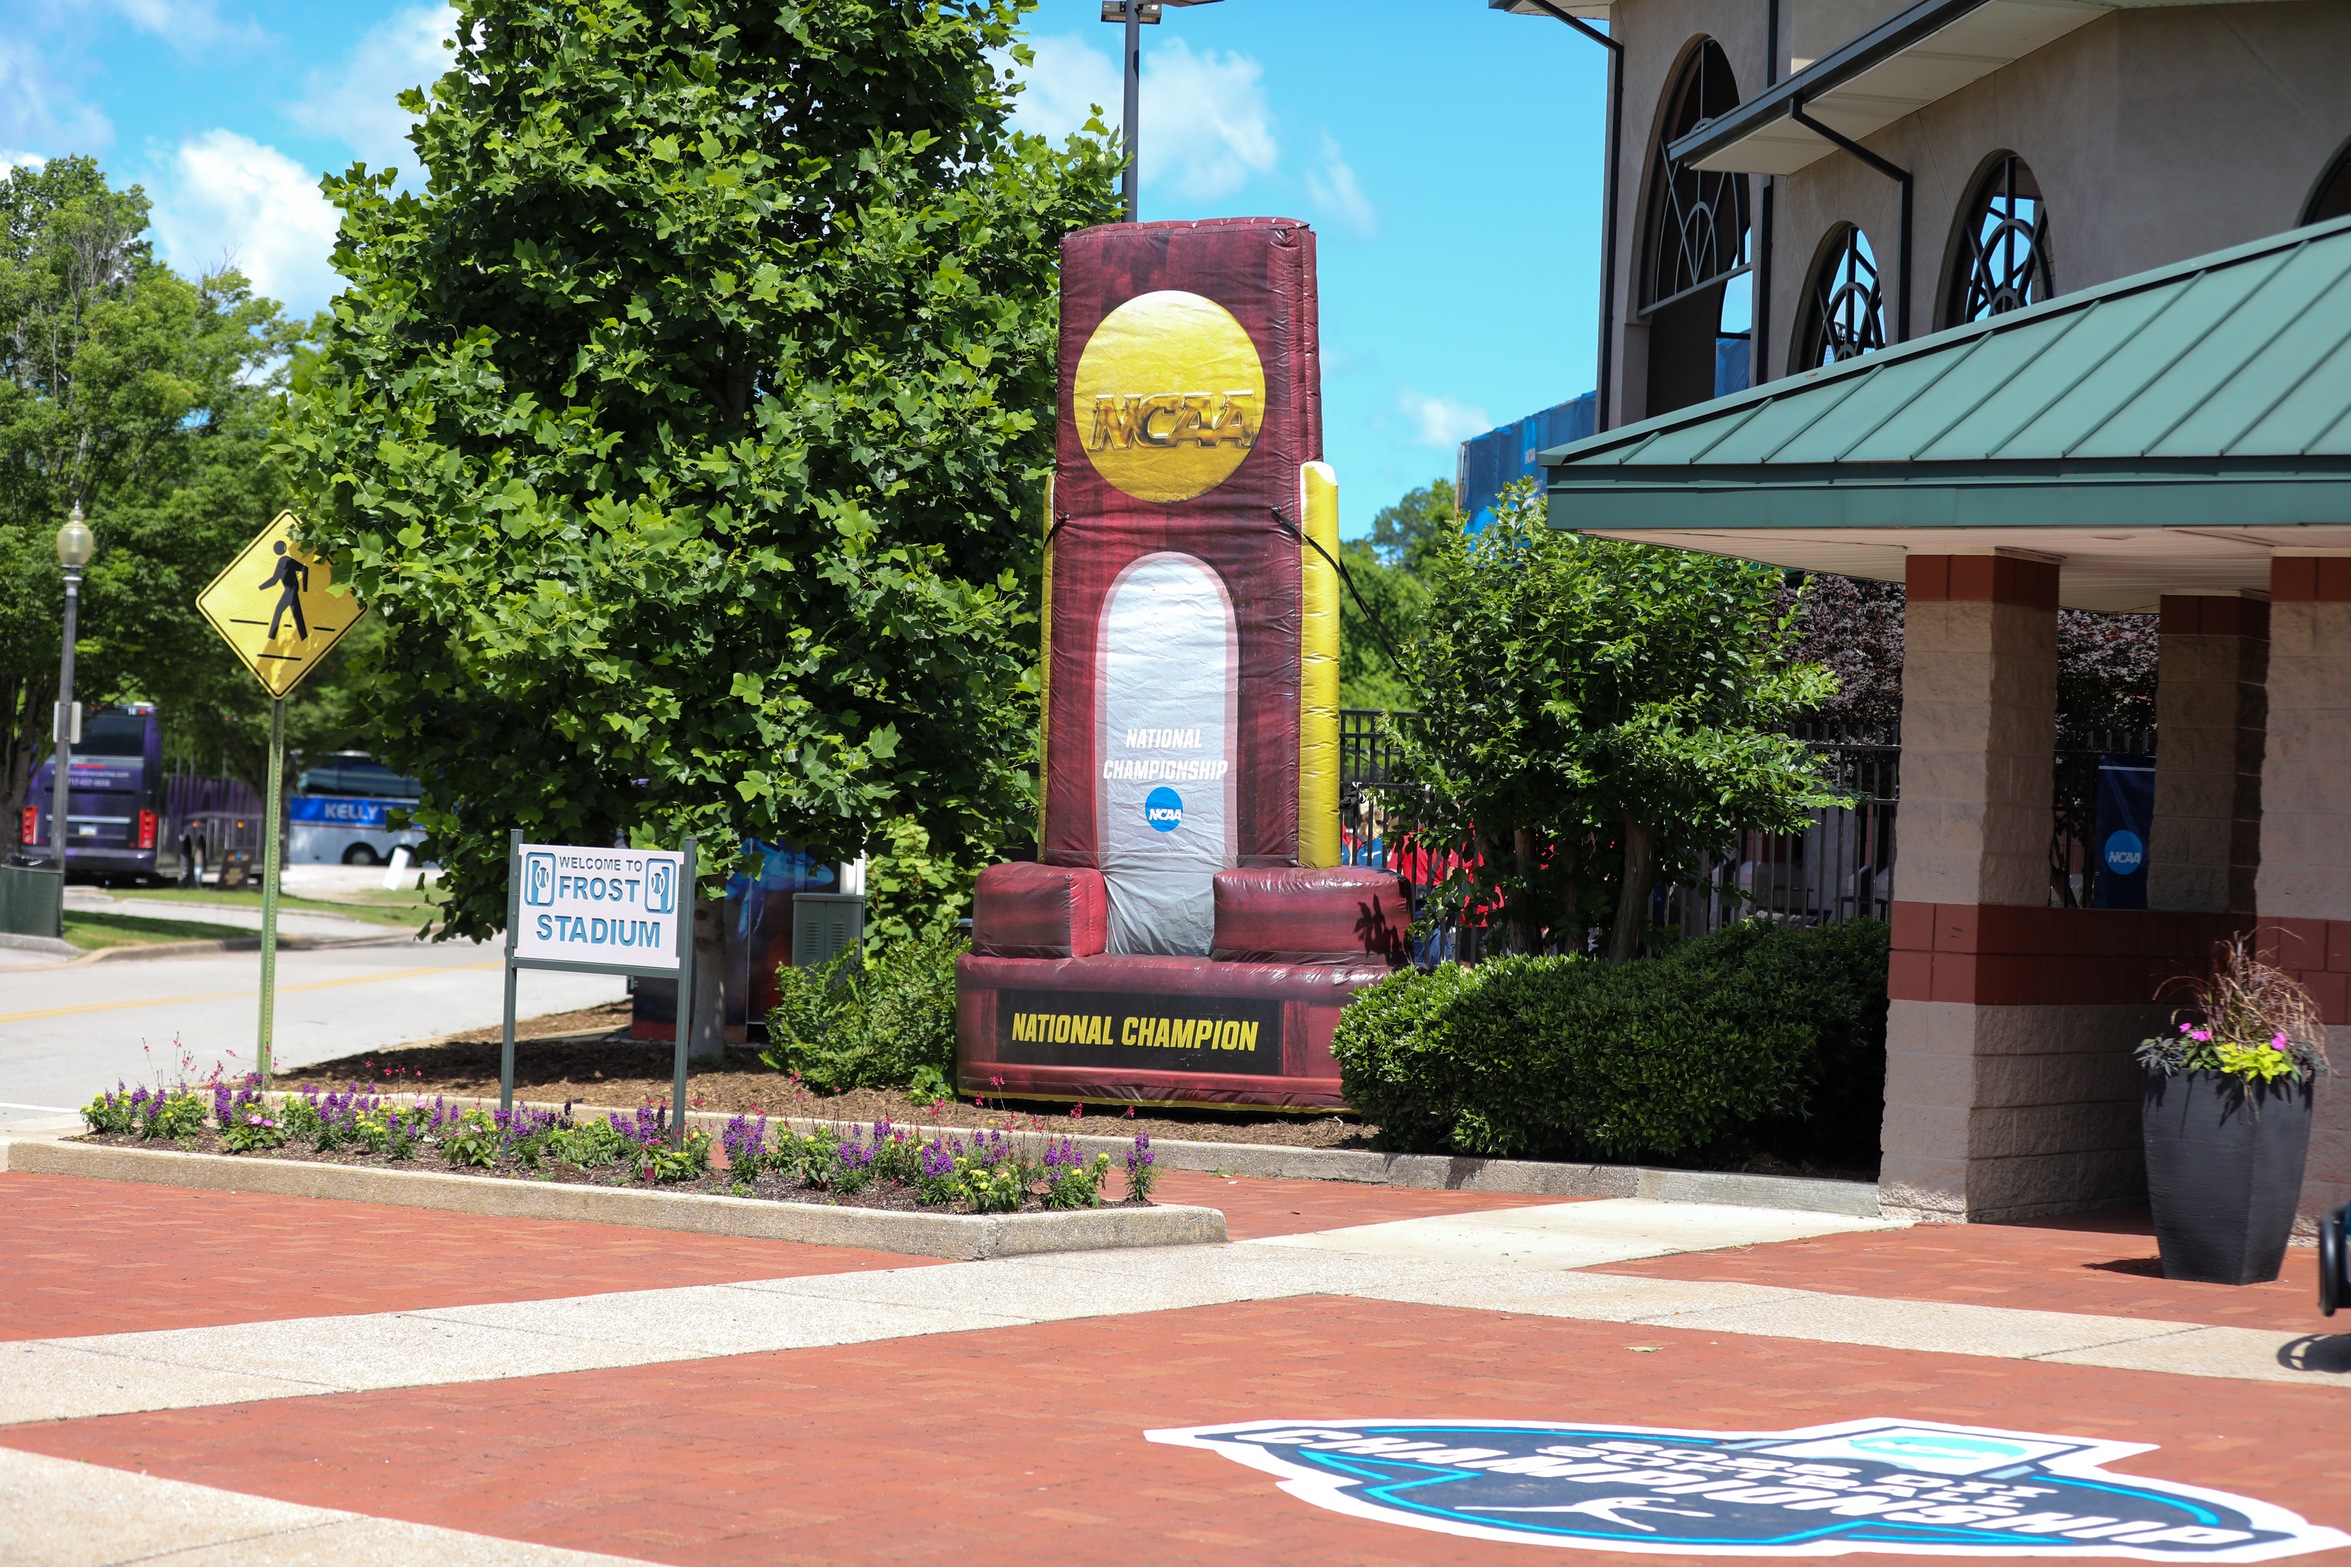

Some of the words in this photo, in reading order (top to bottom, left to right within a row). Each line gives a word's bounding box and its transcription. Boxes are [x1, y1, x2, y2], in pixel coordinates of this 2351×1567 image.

[1087, 389, 1258, 450] NCAA
[1126, 728, 1202, 748] NATIONAL
[1103, 759, 1228, 780] CHAMPIONSHIP
[325, 803, 379, 820] KELLY
[1149, 808, 1182, 821] NCAA
[559, 856, 621, 871] WELCOME
[626, 860, 643, 872] TO
[2108, 851, 2142, 864] NCAA
[558, 876, 640, 902] FROST
[536, 914, 661, 948] STADIUM
[1011, 1013, 1114, 1045] NATIONAL
[1121, 1017, 1259, 1051] CHAMPION
[1587, 1441, 1863, 1478] 2025
[1234, 1429, 2255, 1545] CHAMPIONSHIP
[1536, 1445, 2026, 1508] SOFTBALL
